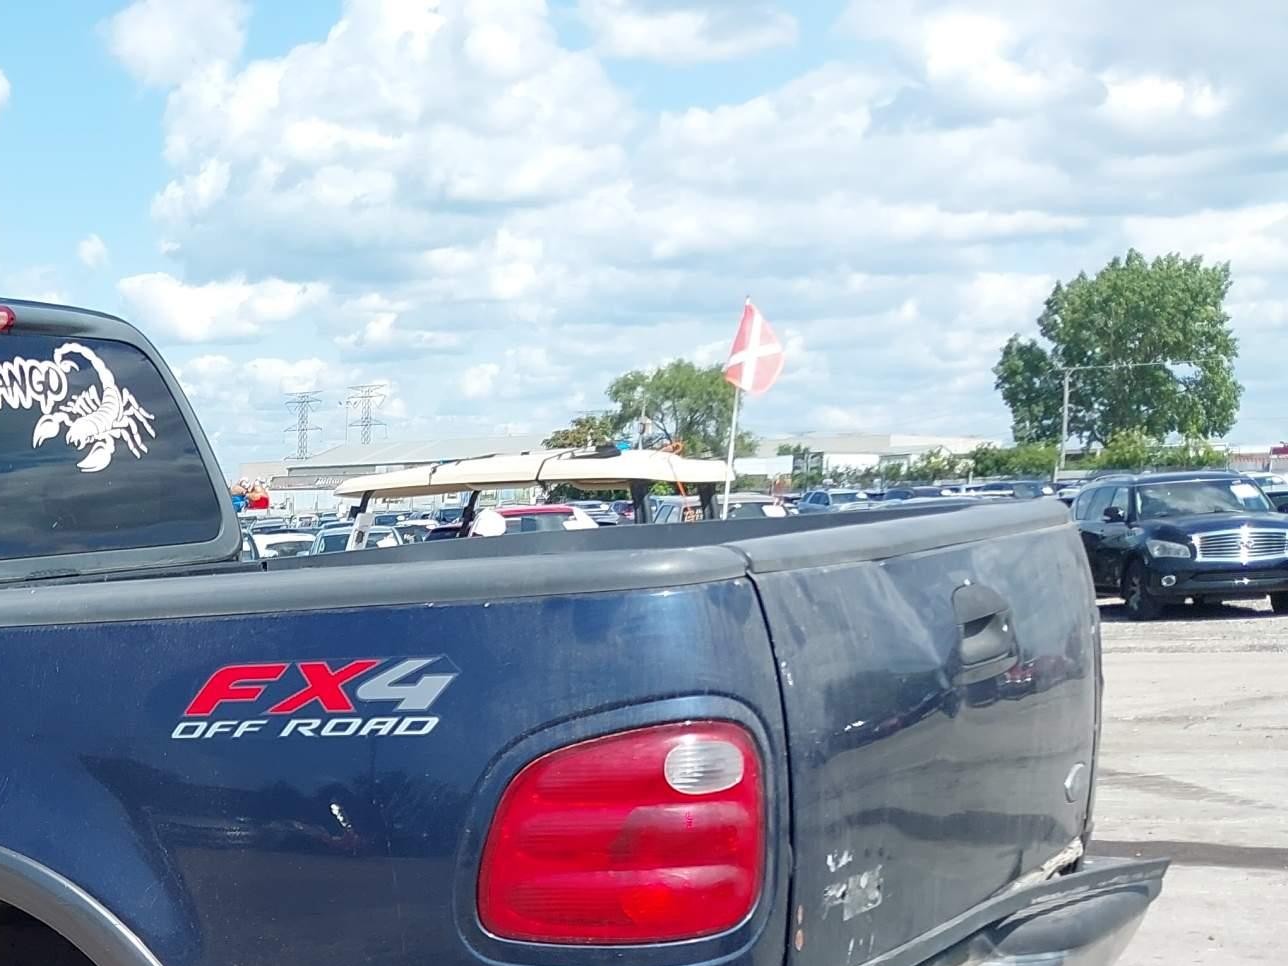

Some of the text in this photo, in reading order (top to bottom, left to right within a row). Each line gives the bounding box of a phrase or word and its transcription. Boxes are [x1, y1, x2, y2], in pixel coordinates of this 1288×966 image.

[183, 658, 459, 716] FX4
[171, 716, 440, 739] OFF ROAD
